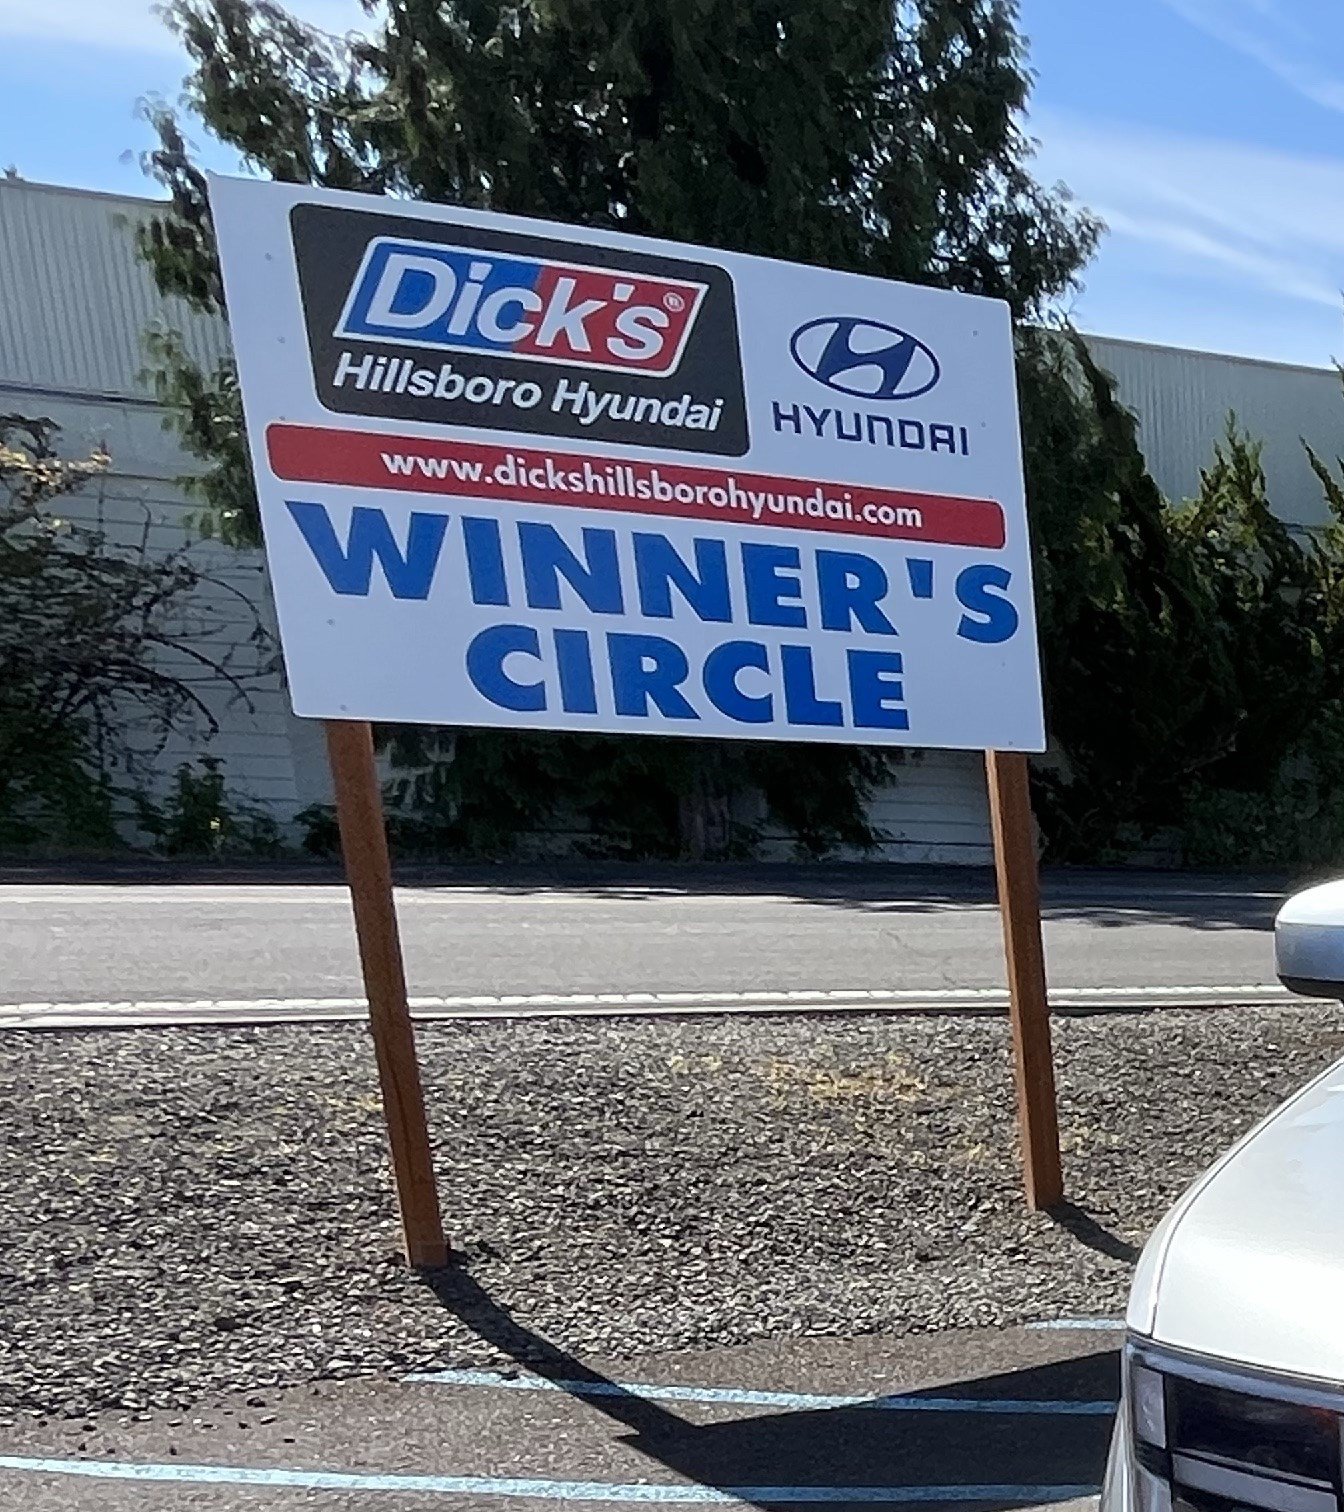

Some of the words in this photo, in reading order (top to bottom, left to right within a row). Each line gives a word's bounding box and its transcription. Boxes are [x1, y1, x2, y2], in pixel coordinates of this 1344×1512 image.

[364, 252, 668, 361] Dick's
[333, 352, 542, 409] Hillsboro
[551, 379, 725, 432] Hyundai
[772, 401, 969, 456] HYUNDAI
[381, 451, 922, 528] www.dickshillsborohyundai.com
[286, 501, 1019, 643] WINNER'S
[466, 624, 909, 730] CIRCLE
